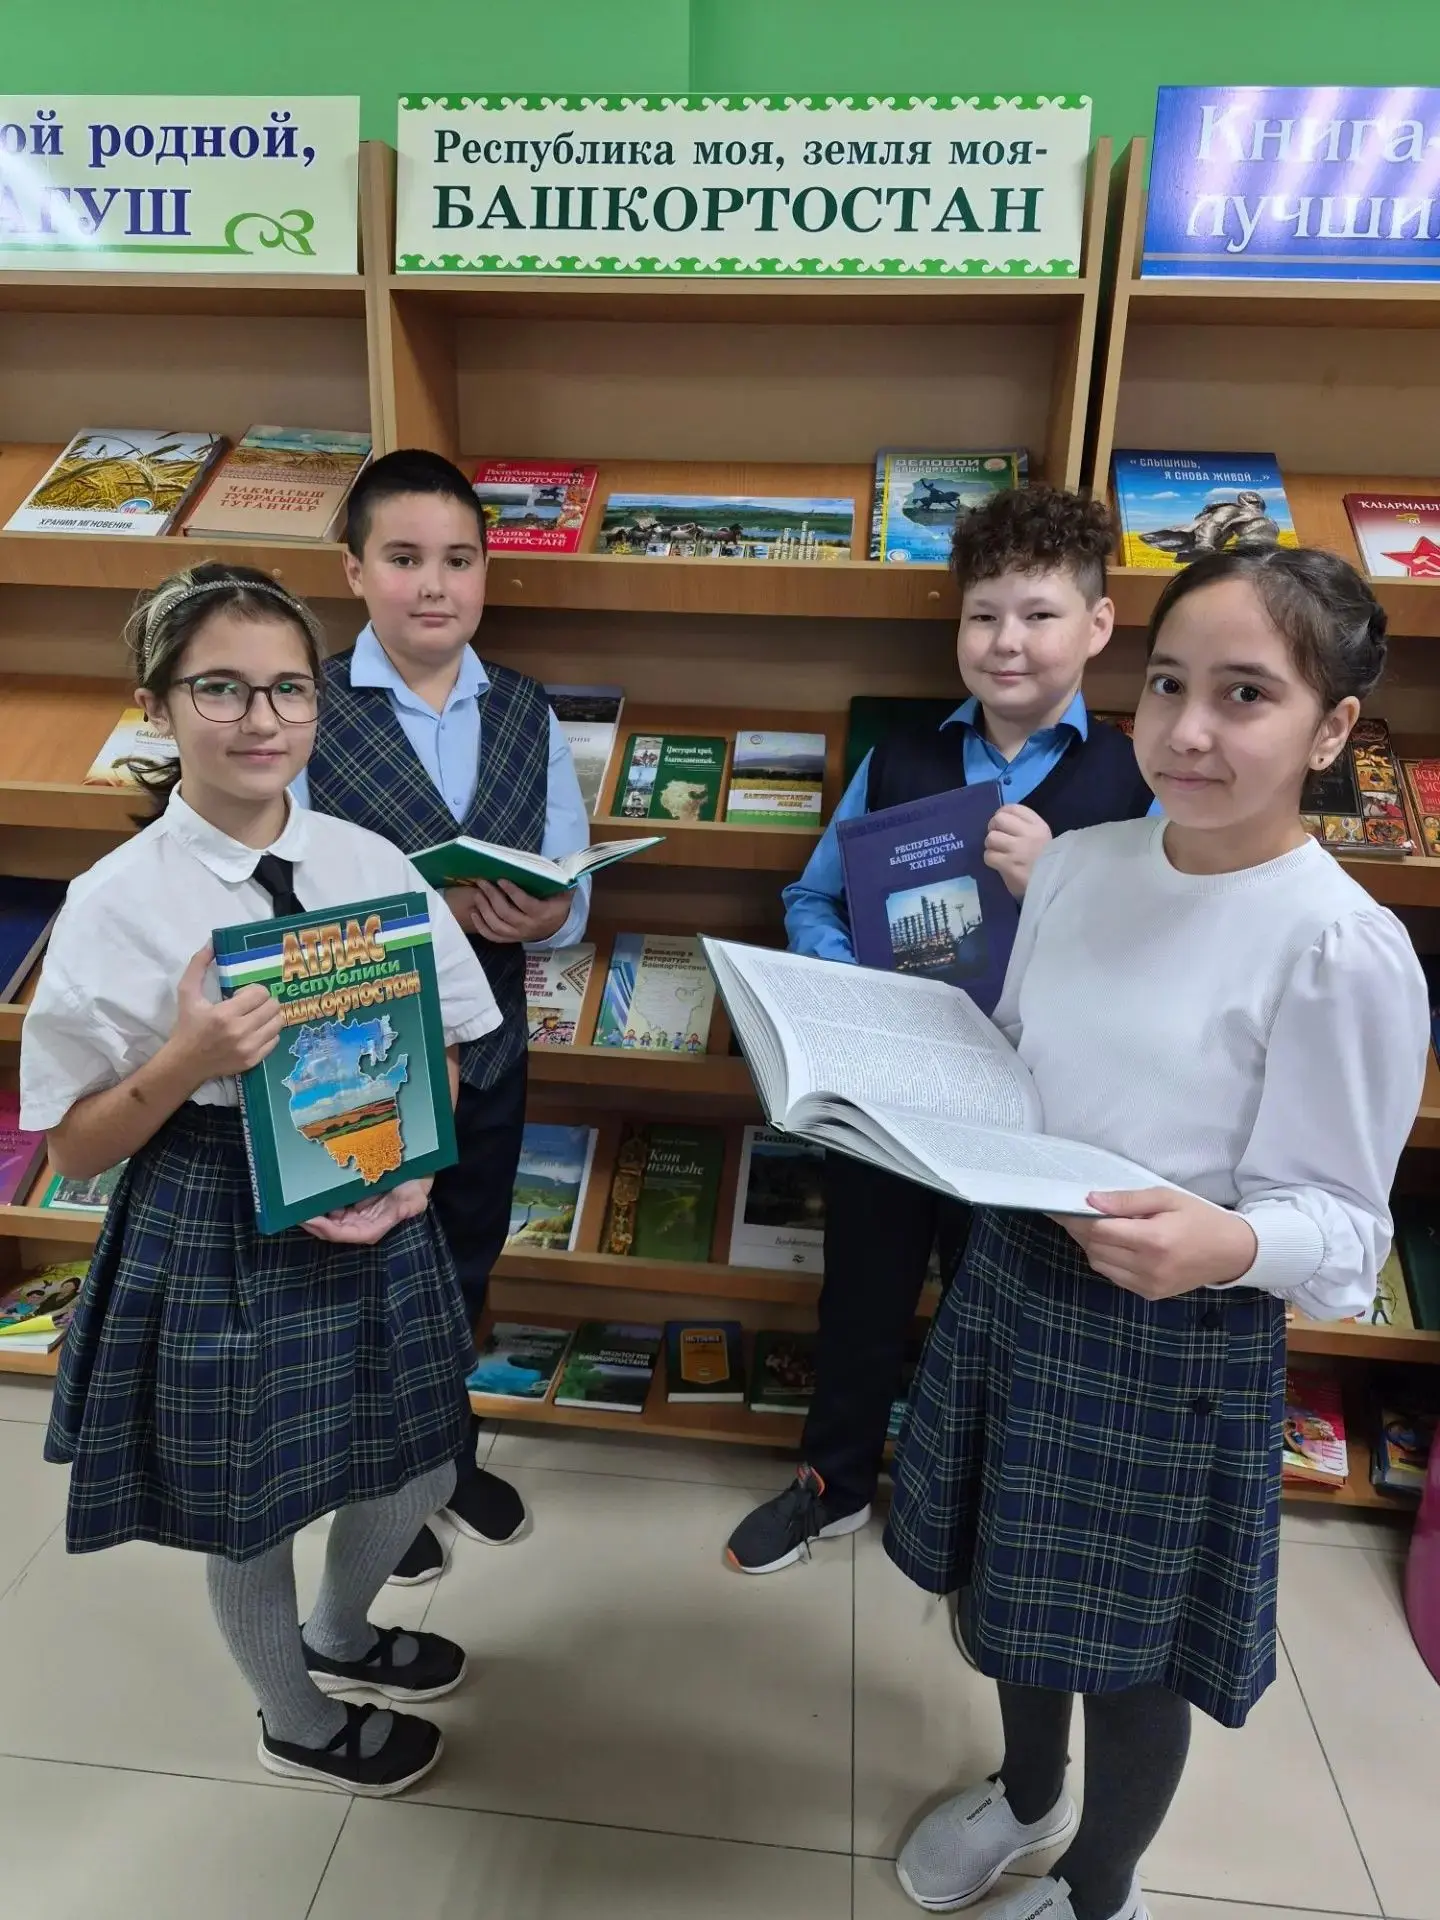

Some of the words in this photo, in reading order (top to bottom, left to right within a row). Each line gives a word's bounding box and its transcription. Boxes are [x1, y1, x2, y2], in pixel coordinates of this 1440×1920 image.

[87, 111, 316, 168] родной,
[433, 129, 676, 173] Республика
[693, 140, 785, 172] моя,
[802, 140, 932, 166] земля
[948, 140, 1047, 166] моя-
[432, 184, 1045, 233] БАШКОРТОСТАН
[1185, 193, 1440, 254] лучши
[1164, 471, 1172, 480] Я
[1175, 471, 1210, 481] СНОВА
[889, 840, 964, 866] БАШКОРТОСТАН
[895, 832, 957, 855] РЕСПУБЛИКА
[927, 855, 946, 867] ВЕК
[281, 914, 386, 982] АТЛАС
[270, 959, 400, 997] Республики
[242, 1118, 262, 1214] БАШКОРТОСТАН
